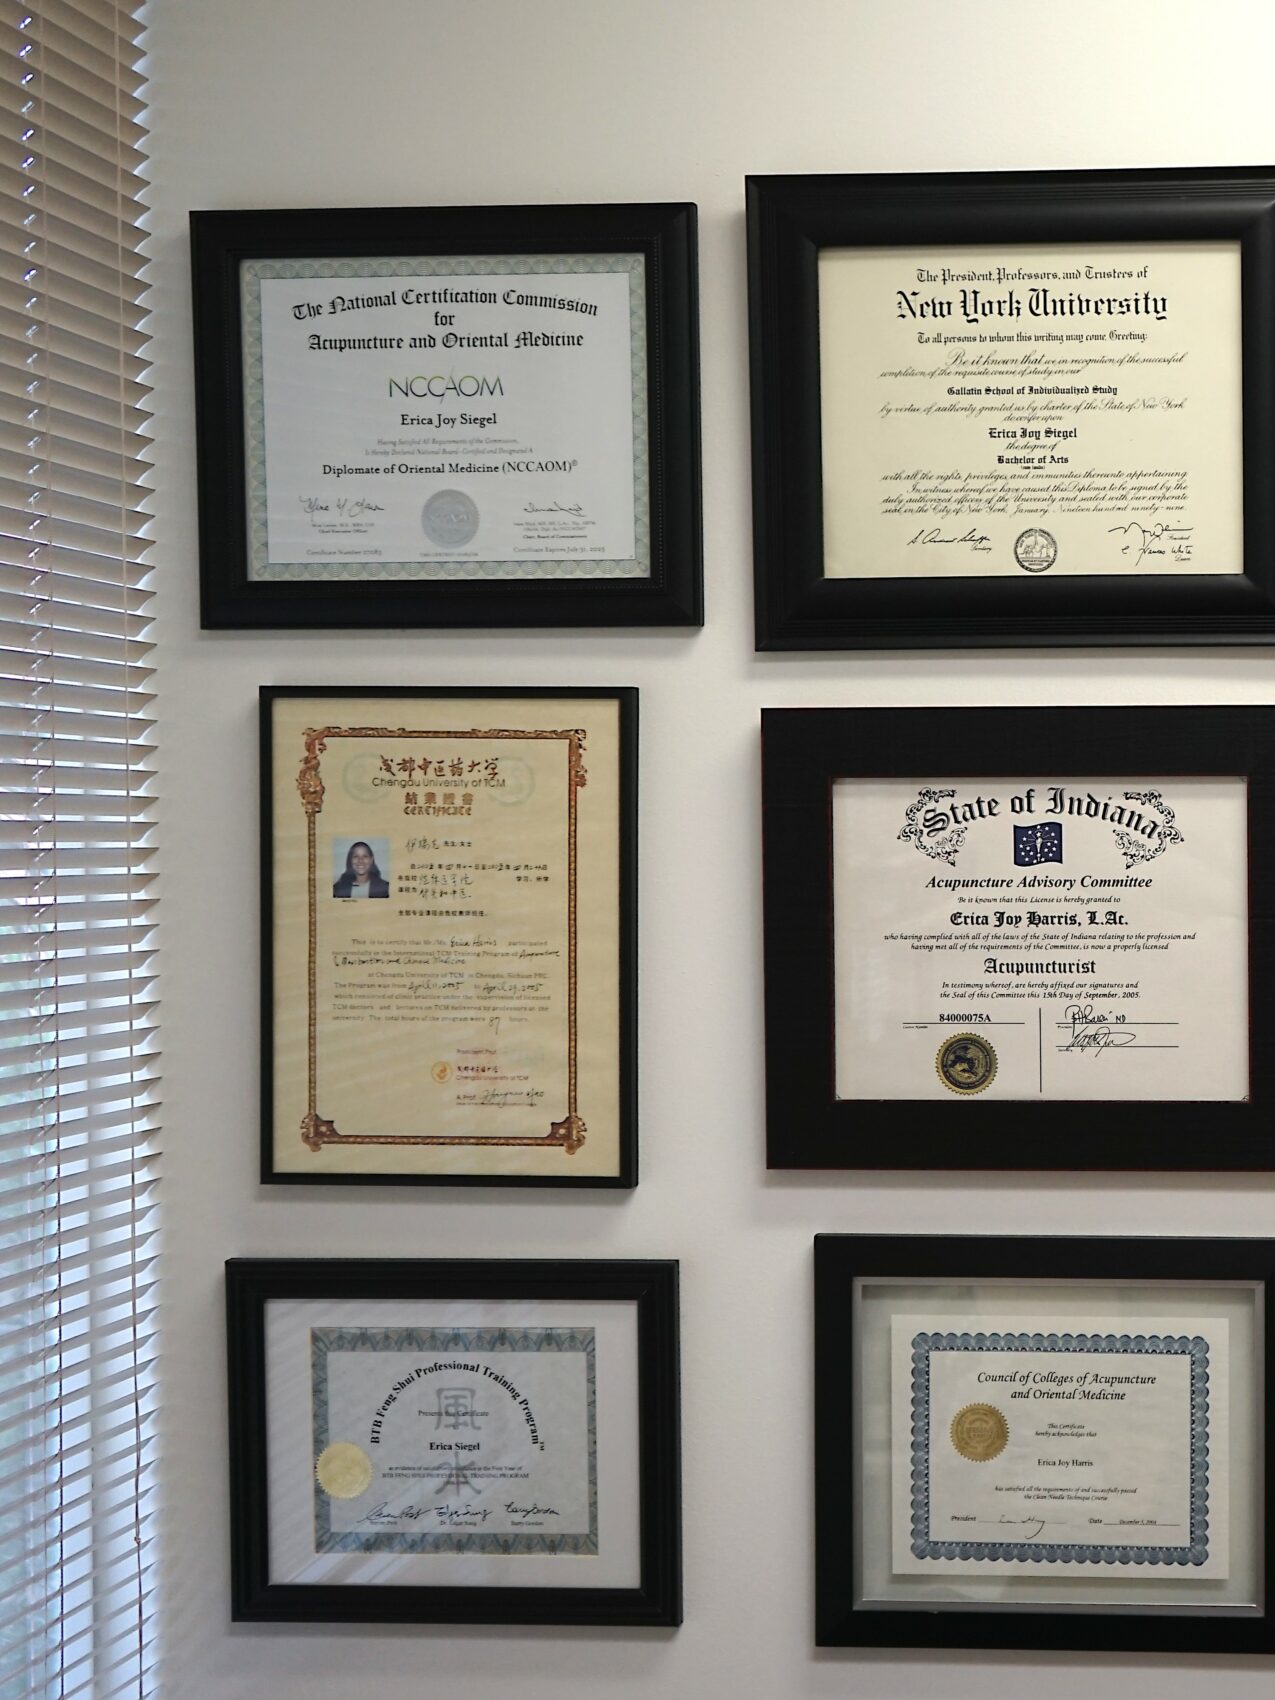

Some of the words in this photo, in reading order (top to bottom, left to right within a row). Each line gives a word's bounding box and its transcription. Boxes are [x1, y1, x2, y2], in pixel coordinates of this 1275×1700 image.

[293, 302, 323, 320] The
[328, 291, 397, 316] National
[402, 289, 497, 305] Certification
[502, 289, 598, 316] Commission
[897, 291, 952, 319] New
[959, 289, 1022, 323] York
[1028, 288, 1168, 320] University
[434, 311, 455, 327] for
[308, 333, 404, 351] Acupuncture
[409, 334, 436, 349] and
[442, 332, 509, 349] Oriental
[514, 331, 584, 348] Medicine
[389, 374, 504, 401] NCCAOM
[947, 386, 982, 396] Gallatin
[985, 386, 1013, 395] School
[1016, 386, 1025, 395] of
[1028, 385, 1089, 395] Individualized
[1092, 385, 1117, 396] Study
[400, 414, 432, 427] Erica
[435, 414, 456, 428] Joy
[460, 413, 497, 427] Siegel
[988, 428, 1018, 439] Erica
[1020, 428, 1041, 440] Joy
[1044, 428, 1077, 439] Siegel
[322, 463, 379, 477] Diplomate
[382, 463, 395, 474] of
[398, 462, 445, 474] Oriental
[448, 462, 499, 474] Medicine
[372, 778, 420, 788] Chengdu
[423, 778, 468, 788] University
[472, 779, 482, 787] of
[484, 779, 506, 787] TCM
[923, 793, 1000, 837] State
[1010, 788, 1036, 814] of
[1045, 787, 1160, 840] Indiana
[926, 876, 1013, 889] Acupuncture
[1017, 876, 1076, 889] Advisory
[1080, 875, 1152, 888] Committee
[950, 912, 989, 927] Erica
[993, 911, 1021, 928] Joy
[1026, 911, 1082, 927] Harris,
[1087, 911, 1128, 926] L.Ac.
[984, 958, 1096, 975] Acupuncturist
[968, 992, 975, 1000] of
[1059, 992, 1073, 1000] Day
[1075, 992, 1082, 1000] of
[939, 1013, 991, 1022] 84000075A
[977, 1372, 1017, 1384] Council
[1020, 1373, 1031, 1386] of
[1032, 1372, 1074, 1386] Colleges
[1076, 1373, 1087, 1386] of
[1089, 1373, 1156, 1386] Acupuncture
[1011, 1389, 1031, 1400] and
[1033, 1389, 1078, 1400] Oriental
[1079, 1389, 1126, 1400] Medicine
[370, 1418, 382, 1444] BTB
[377, 1393, 397, 1418] Feng
[393, 1373, 415, 1393] Shui
[415, 1361, 480, 1379] Professional
[482, 1366, 520, 1400] Training
[519, 1398, 539, 1445] Program
[430, 1442, 451, 1450] Erica
[455, 1442, 480, 1452] Siegel
[1037, 1458, 1056, 1467] Erica
[1059, 1459, 1069, 1469] Joy
[1072, 1459, 1093, 1467] Harris
